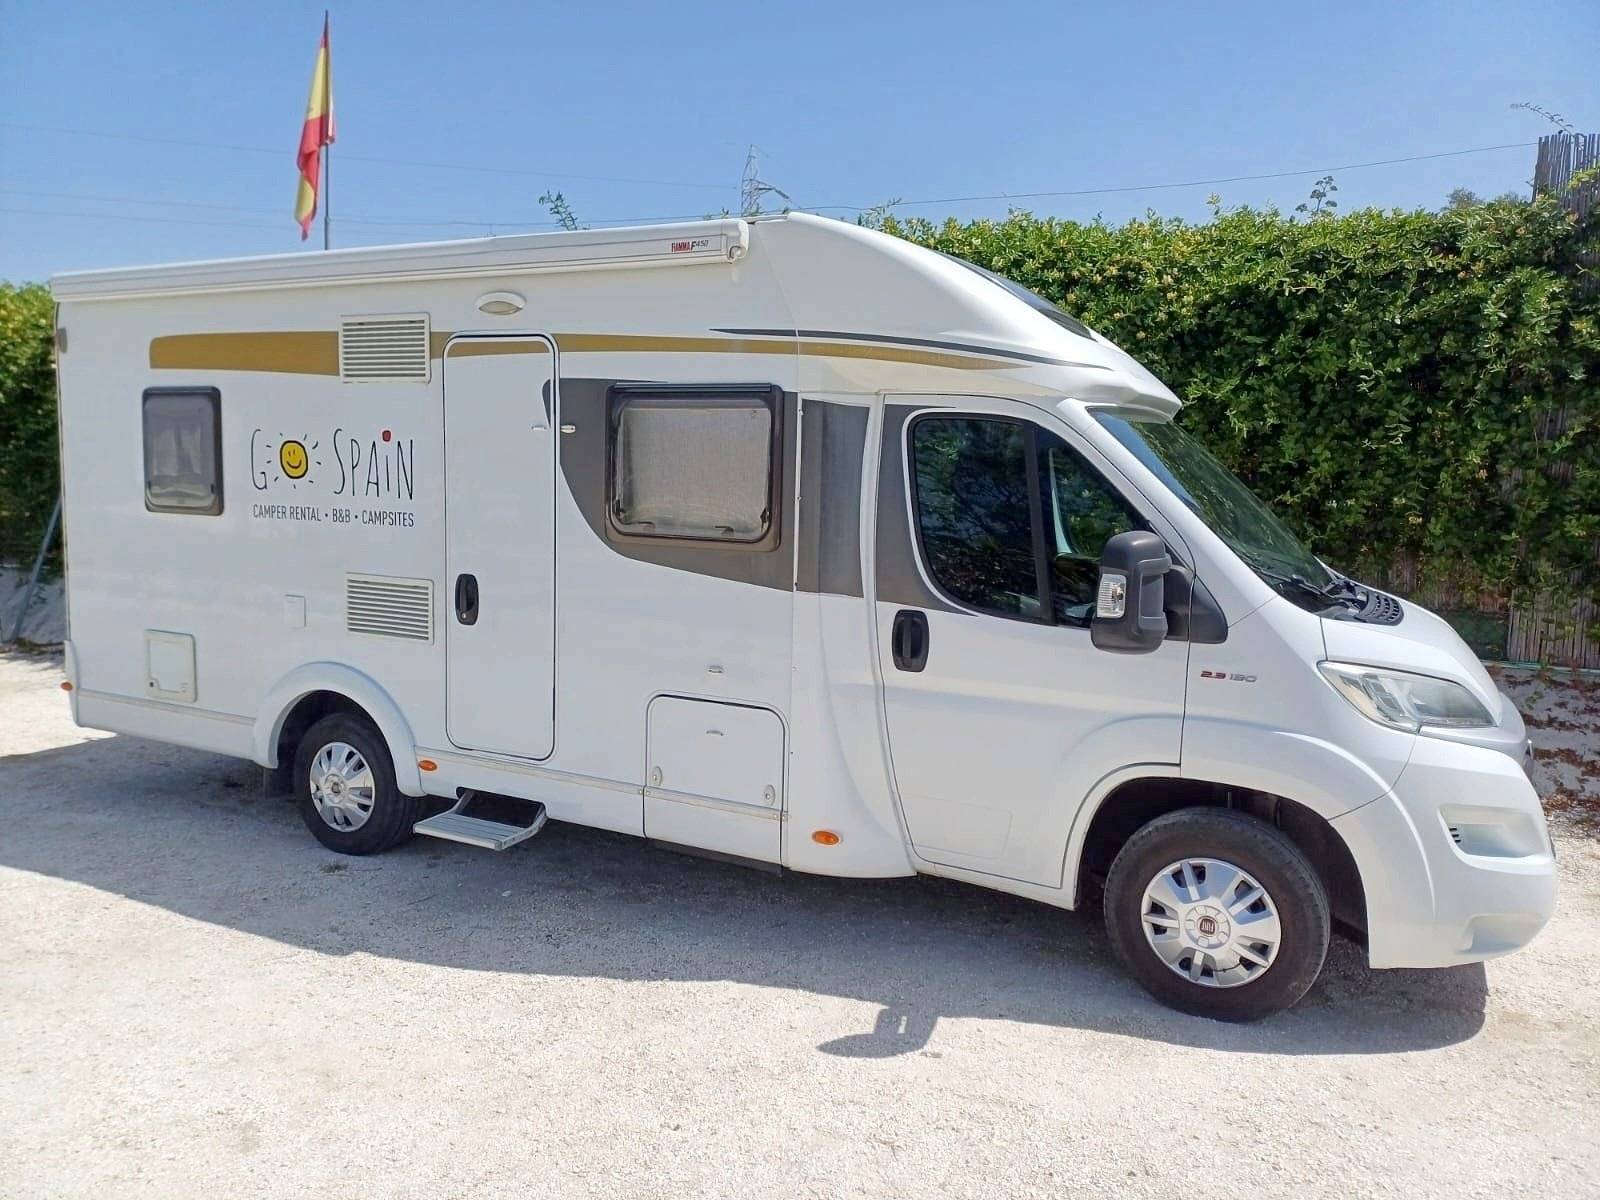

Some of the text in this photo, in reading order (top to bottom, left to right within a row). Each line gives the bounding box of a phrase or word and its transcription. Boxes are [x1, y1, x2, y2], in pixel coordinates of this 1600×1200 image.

[671, 241, 690, 252] FIAMMA
[253, 503, 414, 527] CAMPER RENTAL B&B CAMPSITES
[1200, 670, 1226, 680] 2.3
